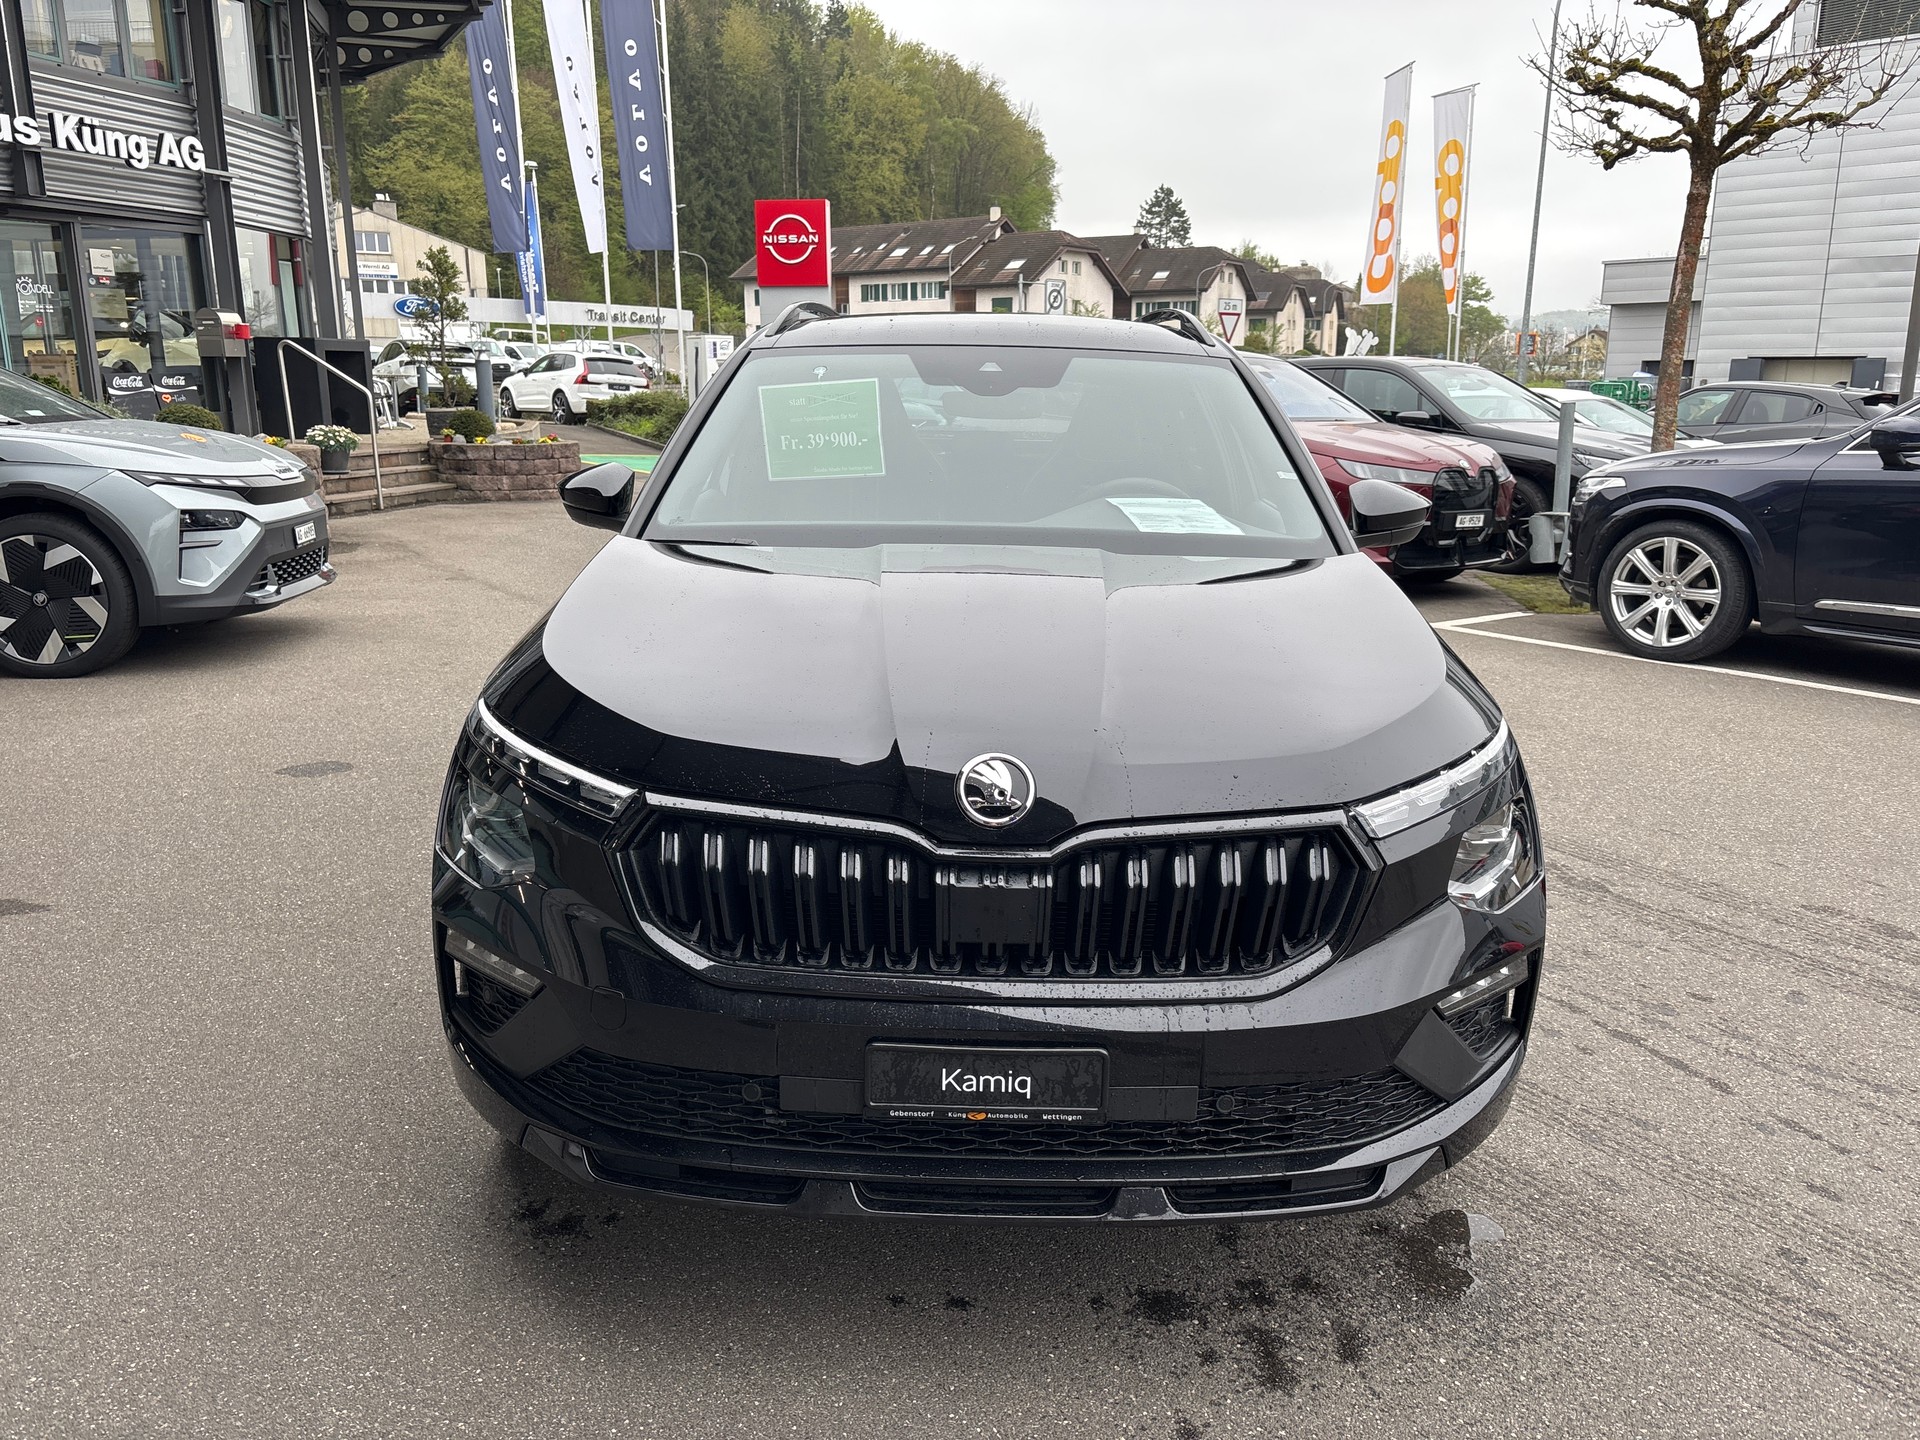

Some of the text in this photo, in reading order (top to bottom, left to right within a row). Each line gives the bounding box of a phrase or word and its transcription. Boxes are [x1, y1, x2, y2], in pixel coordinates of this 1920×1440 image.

[50, 111, 149, 170] Küng
[158, 132, 206, 172] AG
[762, 234, 819, 244] NISSAN
[1223, 301, 1231, 311] 25
[587, 309, 627, 323] Trasit
[780, 435, 803, 451] Fr.
[941, 1067, 1031, 1100] Kamiq
[889, 1109, 935, 1118] Gebenstorf
[987, 1112, 1029, 1120] Automobile
[1042, 1113, 1082, 1121] Wettingen
